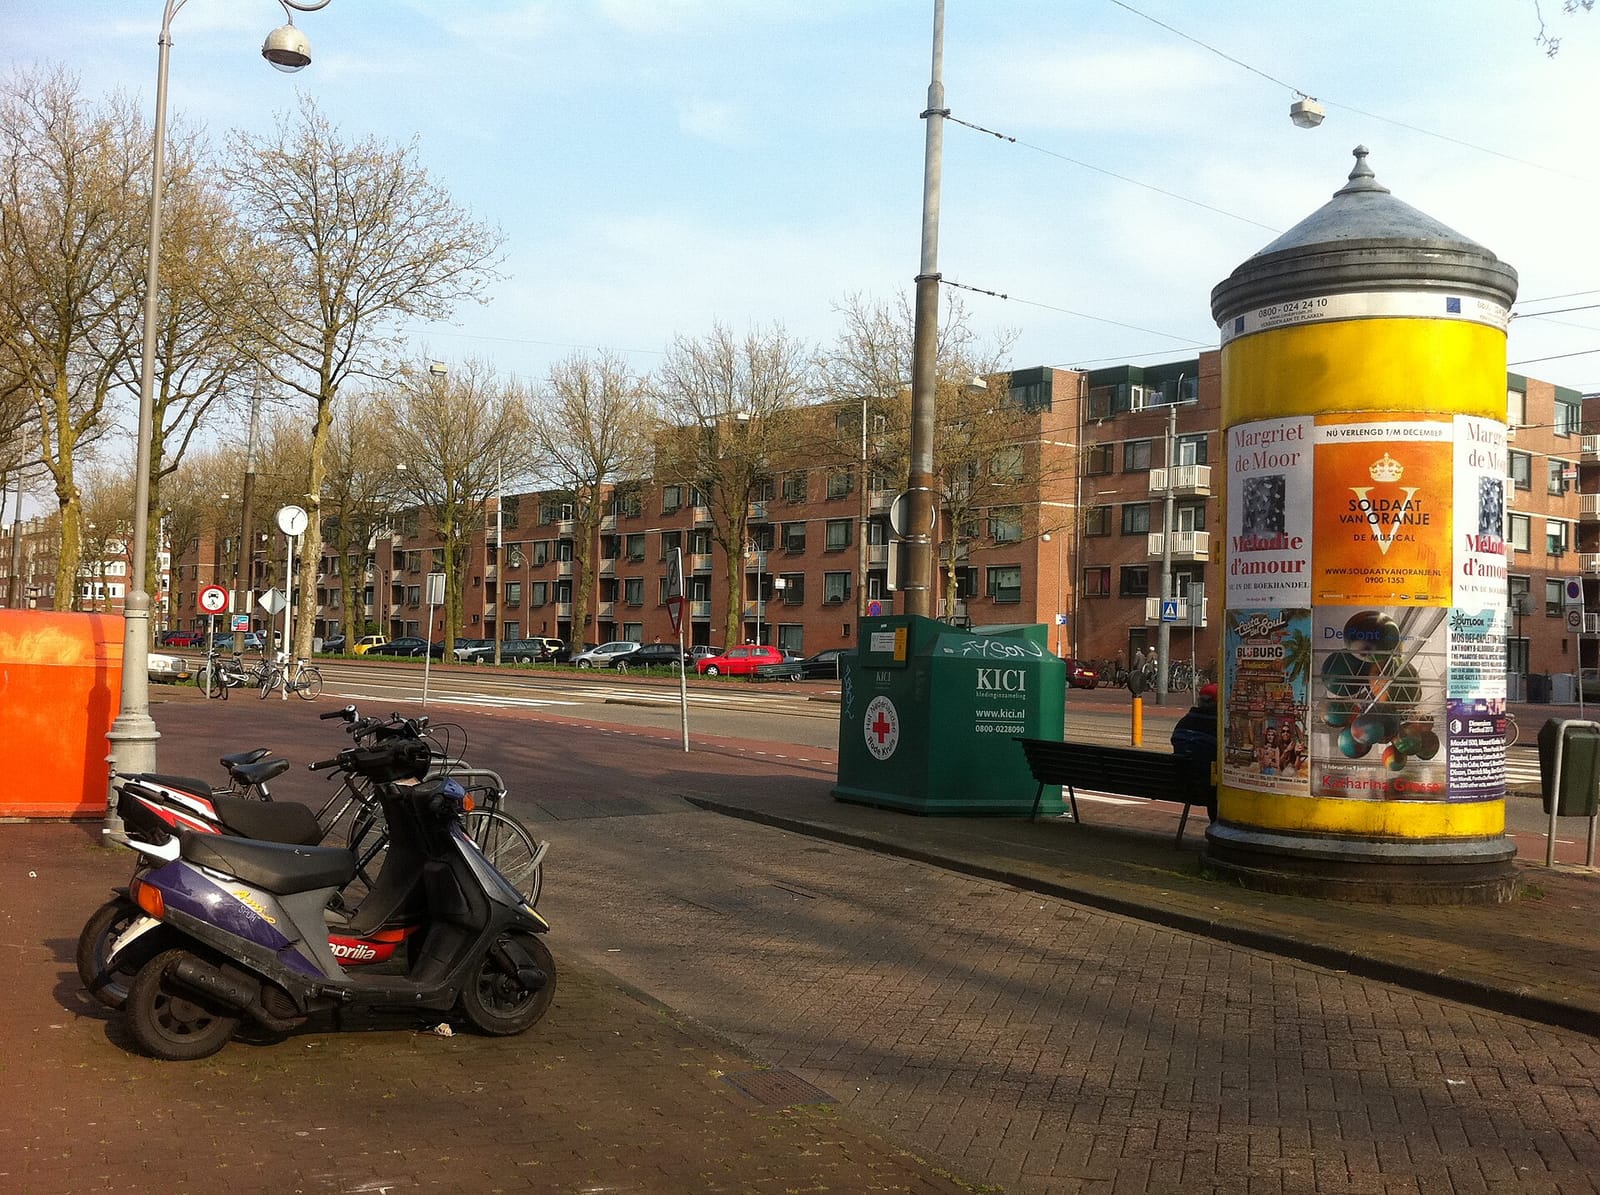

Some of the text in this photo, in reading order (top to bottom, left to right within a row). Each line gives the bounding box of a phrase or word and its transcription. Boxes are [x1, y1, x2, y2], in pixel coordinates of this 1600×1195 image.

[1258, 306, 1277, 318] 0800
[1283, 303, 1299, 313] 024
[1302, 300, 1313, 309] 24
[1317, 298, 1328, 307] 10
[1235, 423, 1304, 448] Margriet
[1340, 428, 1383, 436] VERLENGD
[1386, 428, 1401, 436] T/M
[1403, 429, 1443, 437] DECEMBER
[1235, 450, 1300, 473] de Moor
[1469, 449, 1485, 468] de
[1349, 499, 1422, 512] SOLDAAT
[1340, 512, 1430, 526] VAN ORANJE
[1371, 534, 1416, 542] MUSICAL
[1231, 558, 1306, 576] d'amour
[1325, 568, 1442, 577] WWW.SOLDAATVANORANJE.NL
[1253, 581, 1309, 590] BOEKHANDEL
[1260, 611, 1286, 636] Soul
[1324, 627, 1343, 639] De
[1348, 628, 1381, 641] Pont
[976, 668, 1027, 691] KICI
[976, 708, 1025, 719] www.kici.nl
[975, 724, 1025, 734] 0800-0228090
[328, 943, 376, 960] aprilia
